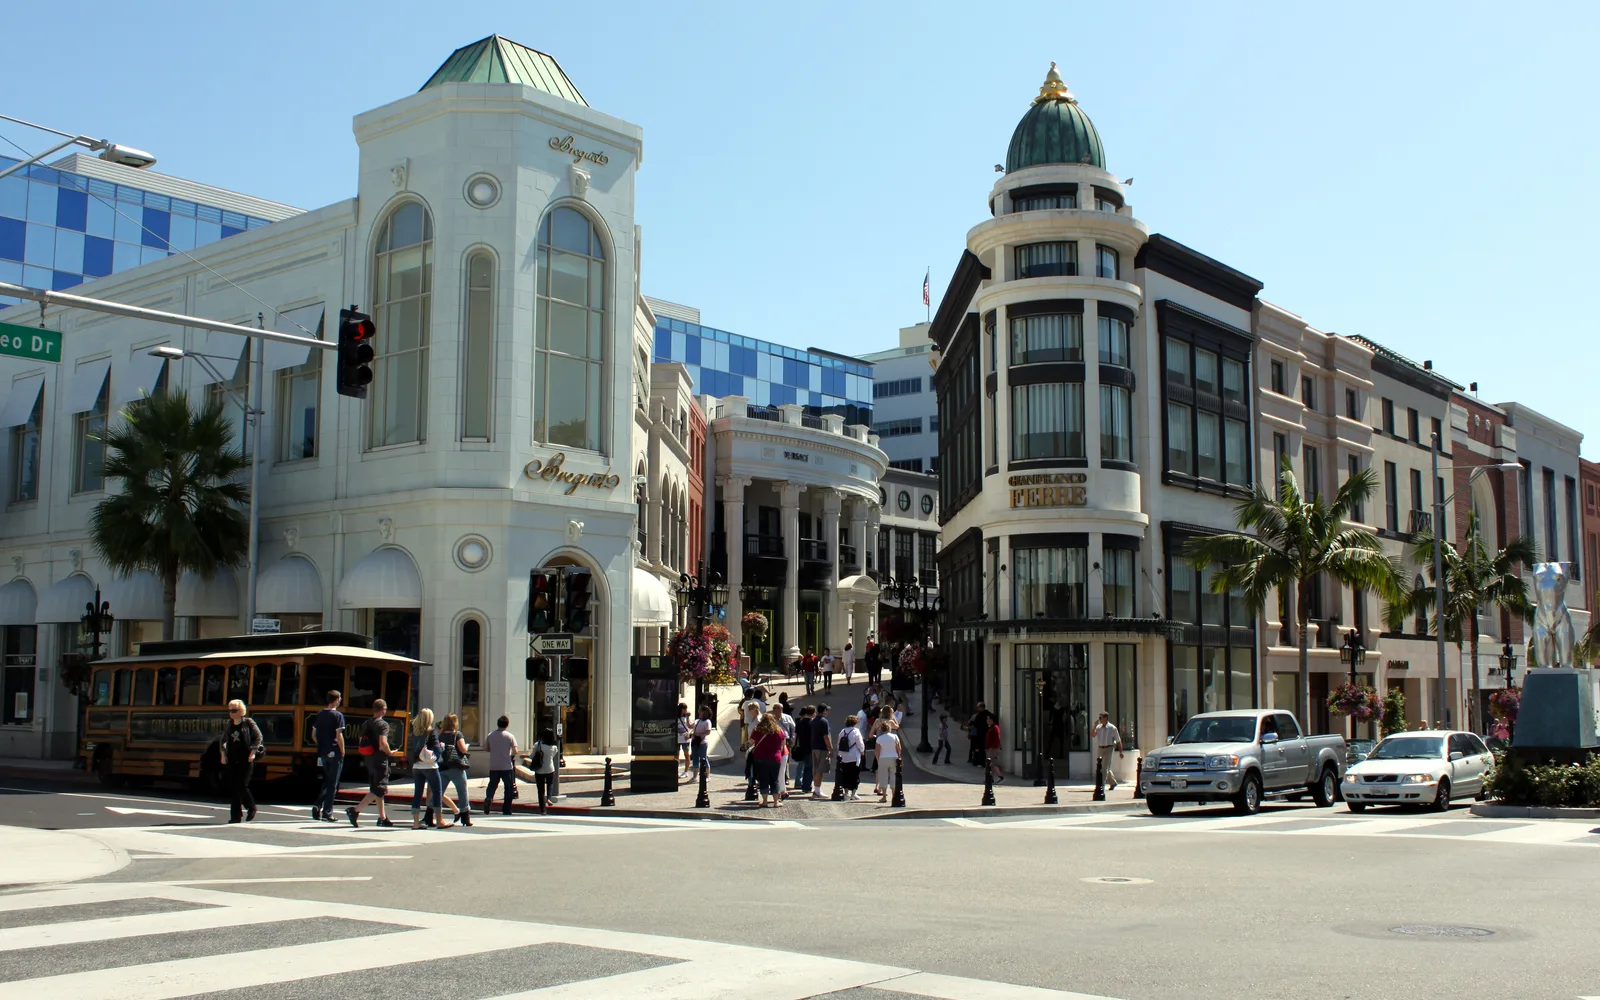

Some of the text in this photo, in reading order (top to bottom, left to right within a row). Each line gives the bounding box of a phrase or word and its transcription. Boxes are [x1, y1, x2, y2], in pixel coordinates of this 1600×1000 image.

[548, 135, 609, 166] Breguet
[31, 335, 54, 354] Dr
[783, 450, 809, 463] VERSACE
[523, 452, 620, 495] Breguet
[1008, 472, 1087, 487] GIANFRANCO
[1009, 486, 1088, 508] FERRE
[541, 640, 569, 648] ONE WAY
[546, 695, 555, 703] OK
[151, 719, 165, 732] CITY
[168, 719, 177, 732] OF
[180, 719, 208, 732] BEVERLY
[643, 725, 672, 734] parking
